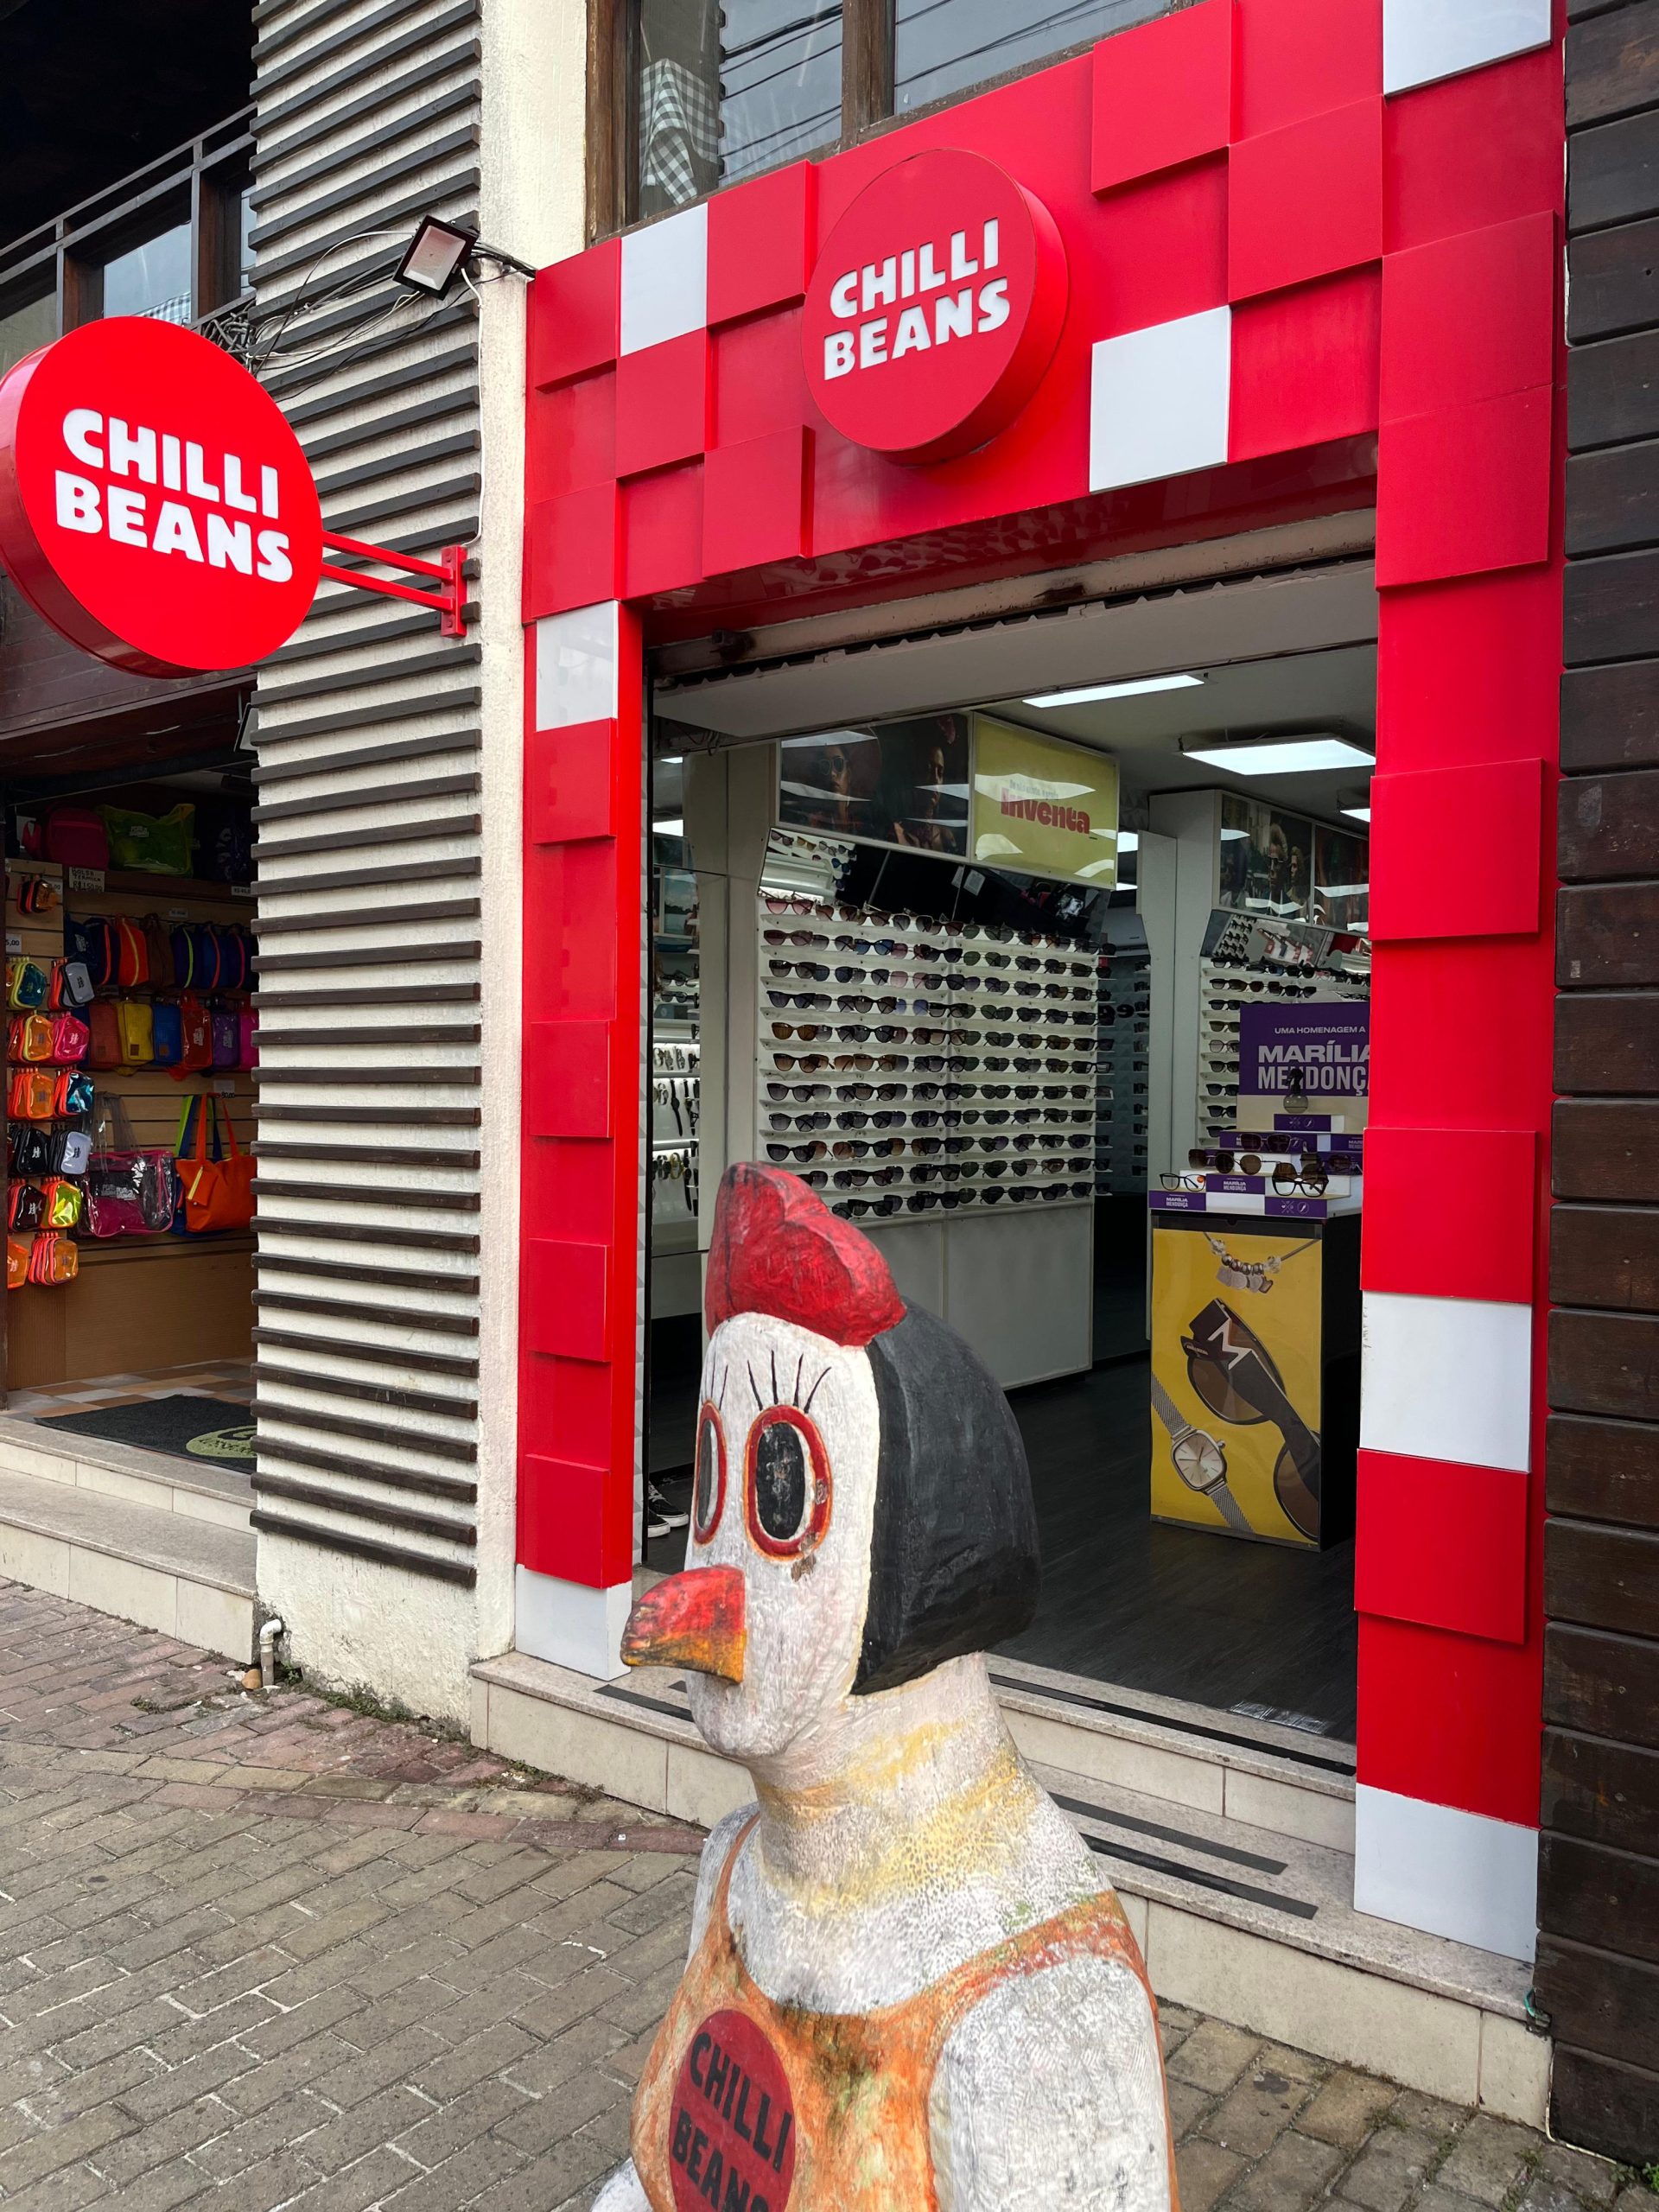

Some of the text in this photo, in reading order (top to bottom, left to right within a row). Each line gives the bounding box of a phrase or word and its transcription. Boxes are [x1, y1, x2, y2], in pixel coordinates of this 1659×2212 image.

[830, 216, 999, 319] CHILLI
[823, 276, 1010, 380] BEANS
[62, 408, 278, 519] CHILLI
[54, 469, 293, 582] BEANS
[1296, 1026, 1357, 1034] HOMENAGEM
[690, 2032, 791, 2172] CHILLI
[672, 2108, 768, 2212] BEAN
